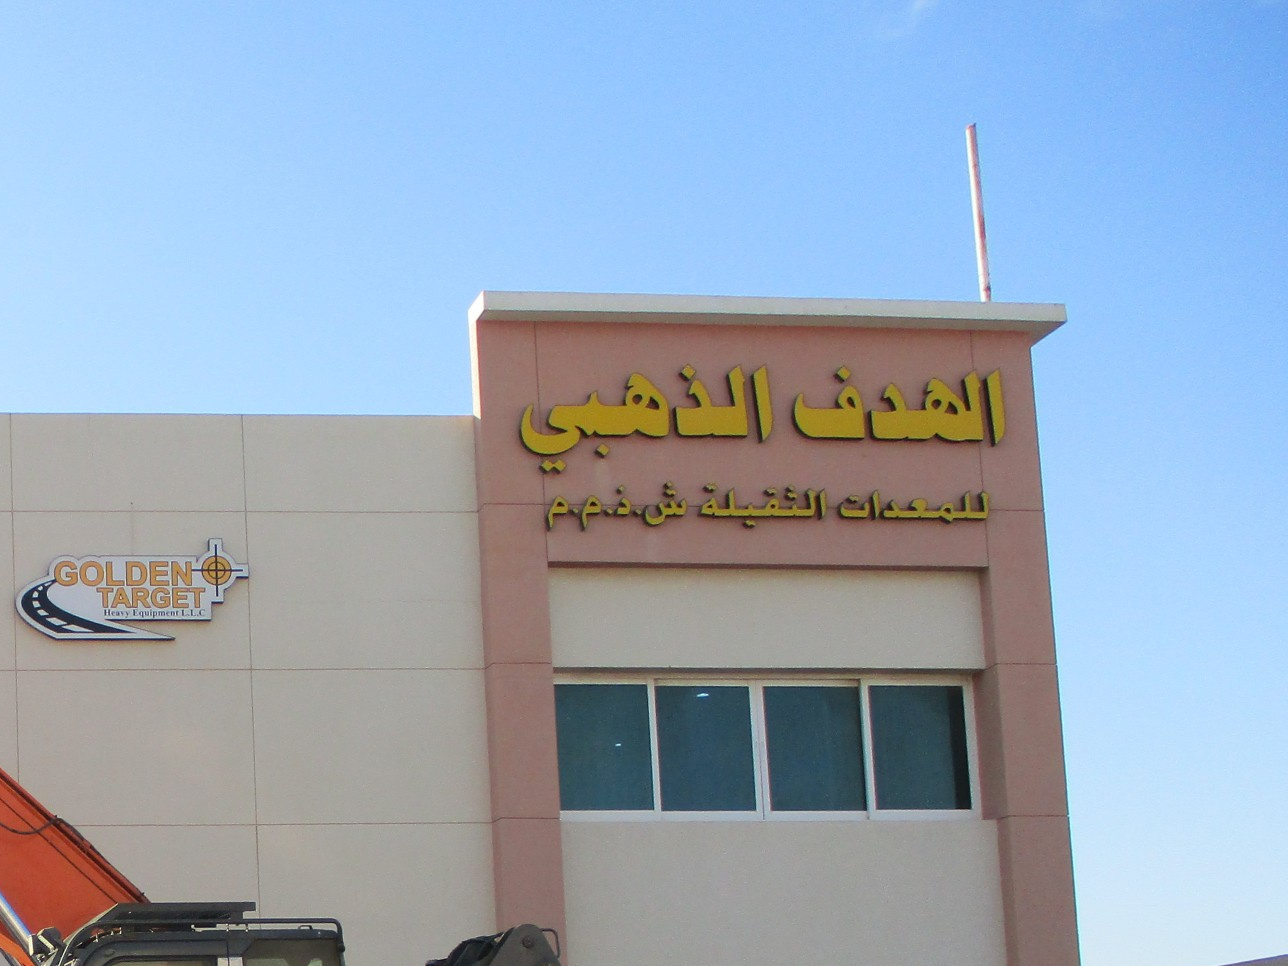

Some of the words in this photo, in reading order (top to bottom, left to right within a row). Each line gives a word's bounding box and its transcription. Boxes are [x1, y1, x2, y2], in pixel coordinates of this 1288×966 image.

[520, 363, 774, 473] الذهبي
[792, 366, 1006, 447] الهدف
[700, 482, 827, 528] الثقيلة
[839, 489, 989, 523] للمعدات
[53, 560, 193, 587] GOLDEN
[96, 587, 206, 609] TARGET
[103, 609, 130, 618] Heavy
[132, 609, 179, 618] Equipment
[181, 609, 206, 617] L.L.C
